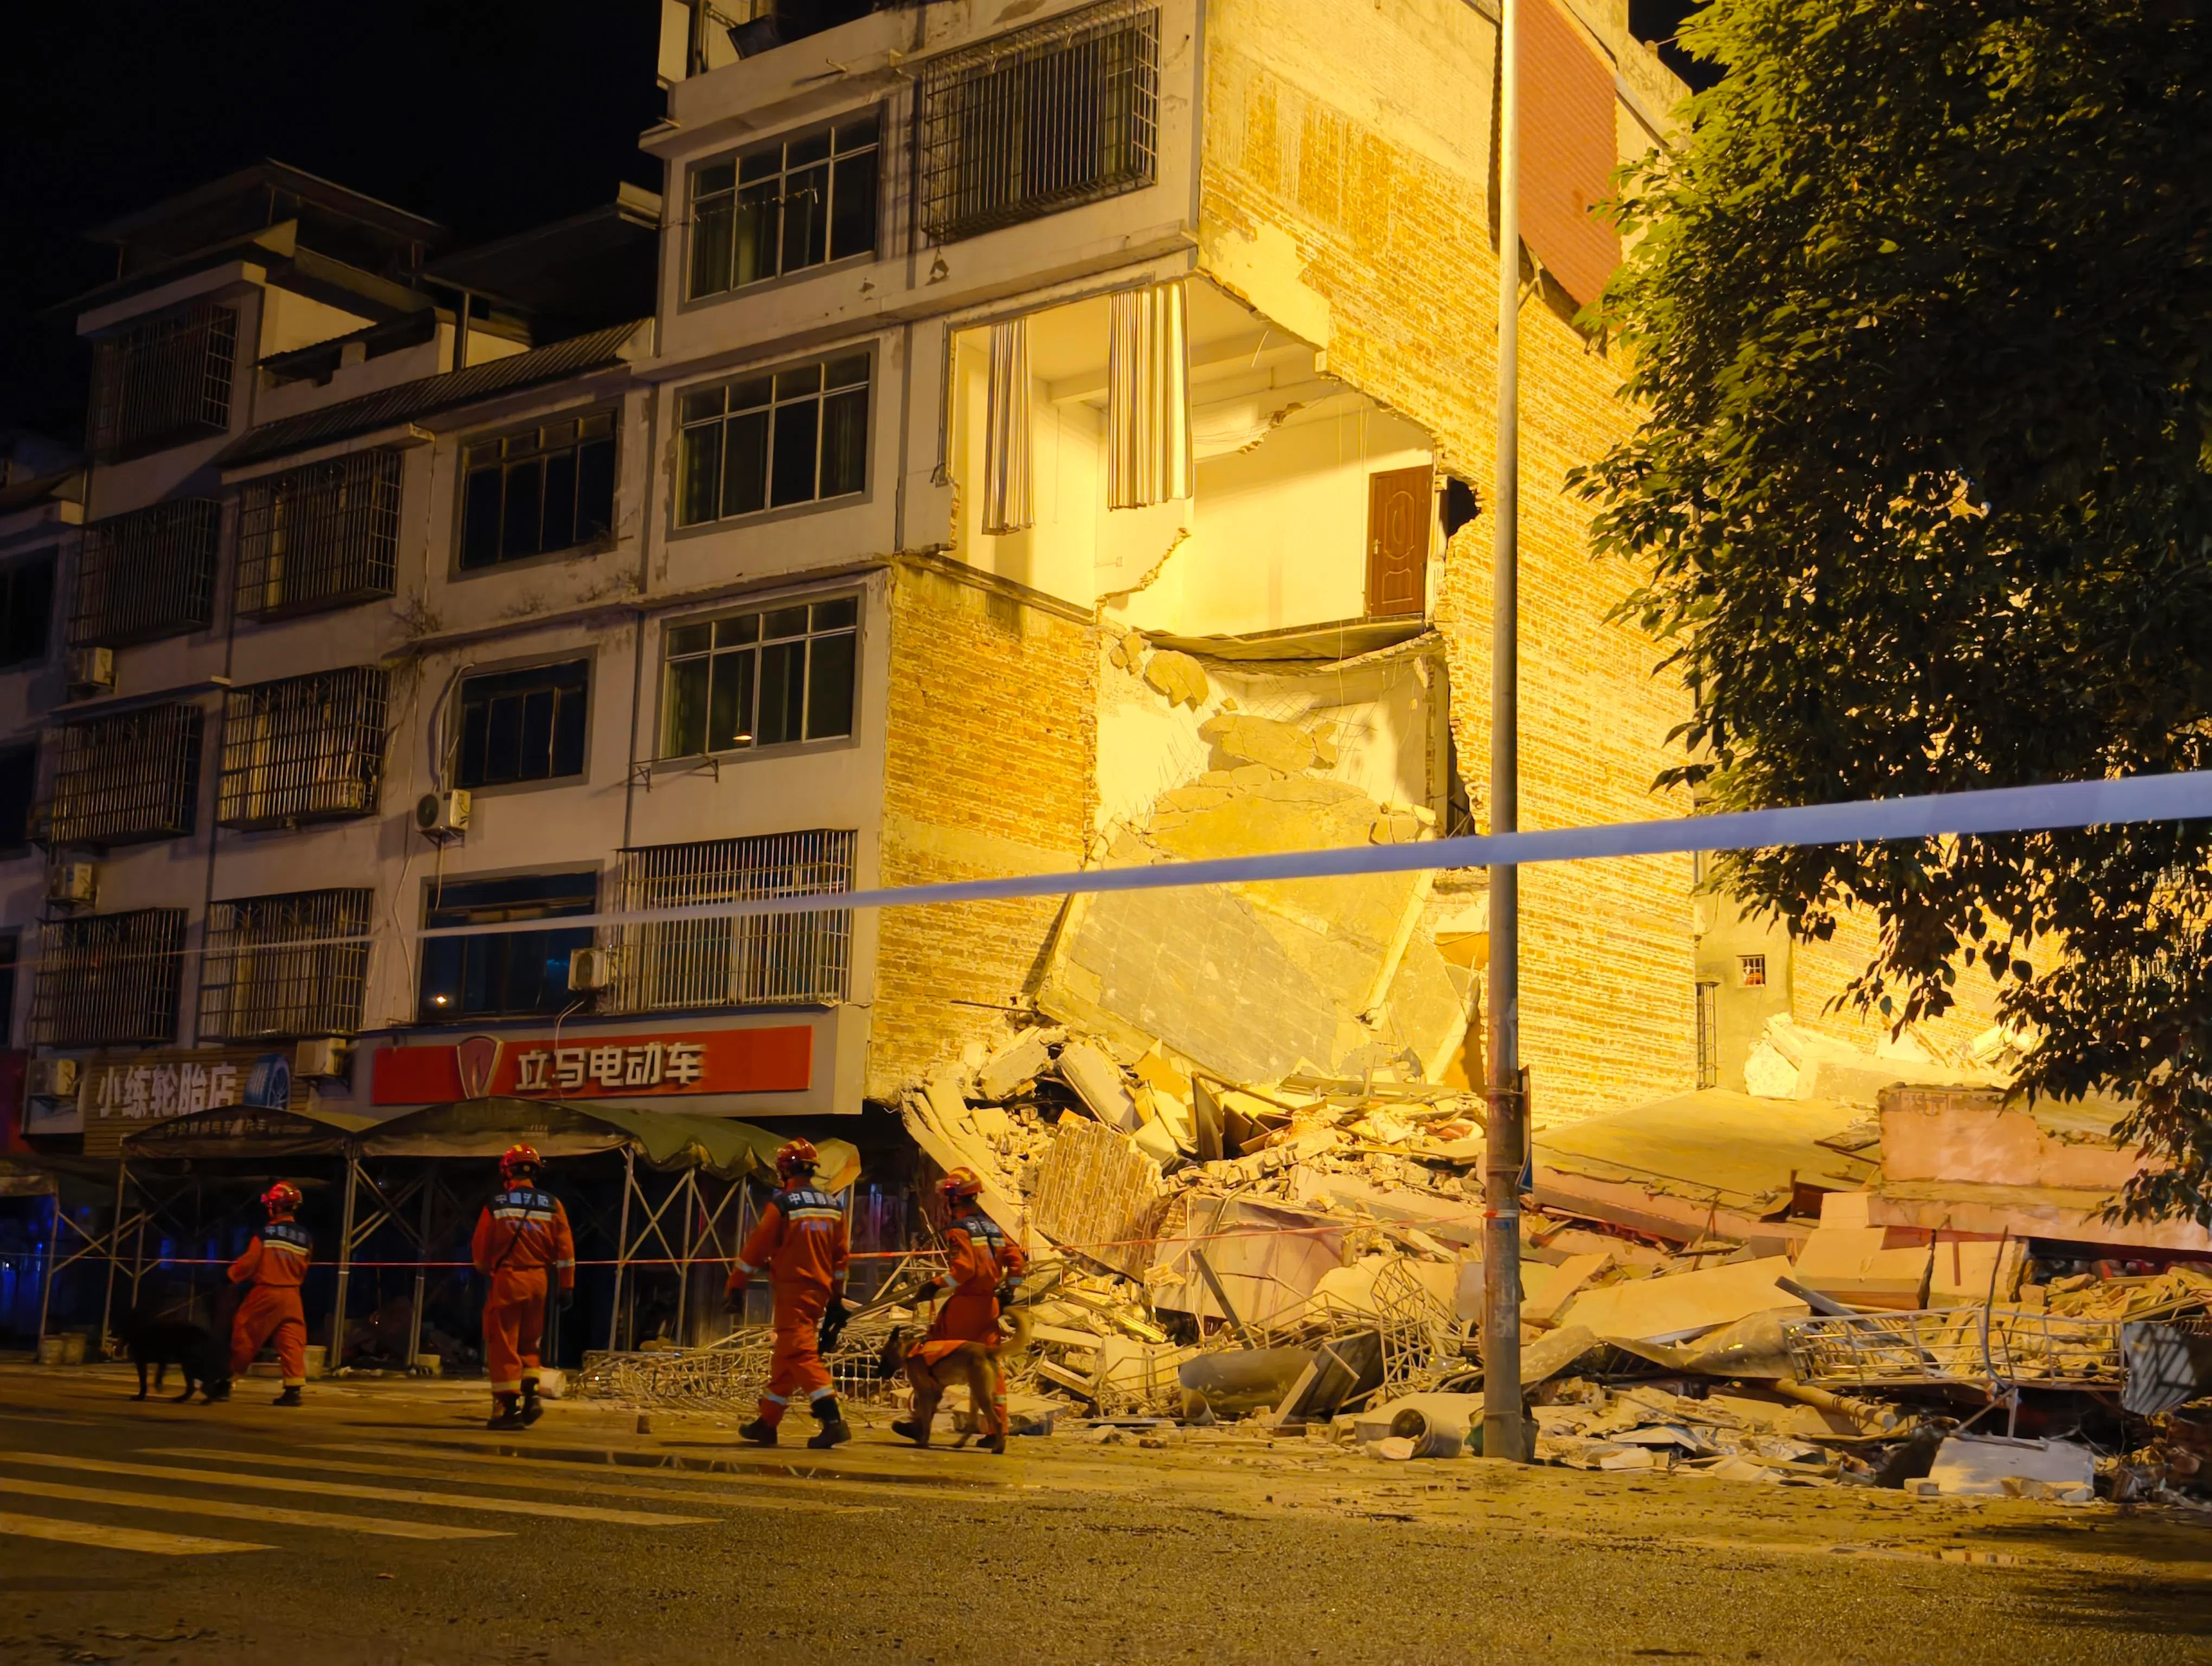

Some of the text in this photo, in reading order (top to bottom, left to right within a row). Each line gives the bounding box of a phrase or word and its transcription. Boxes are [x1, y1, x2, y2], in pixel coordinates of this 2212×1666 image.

[515, 1041, 706, 1091] 立马电动车
